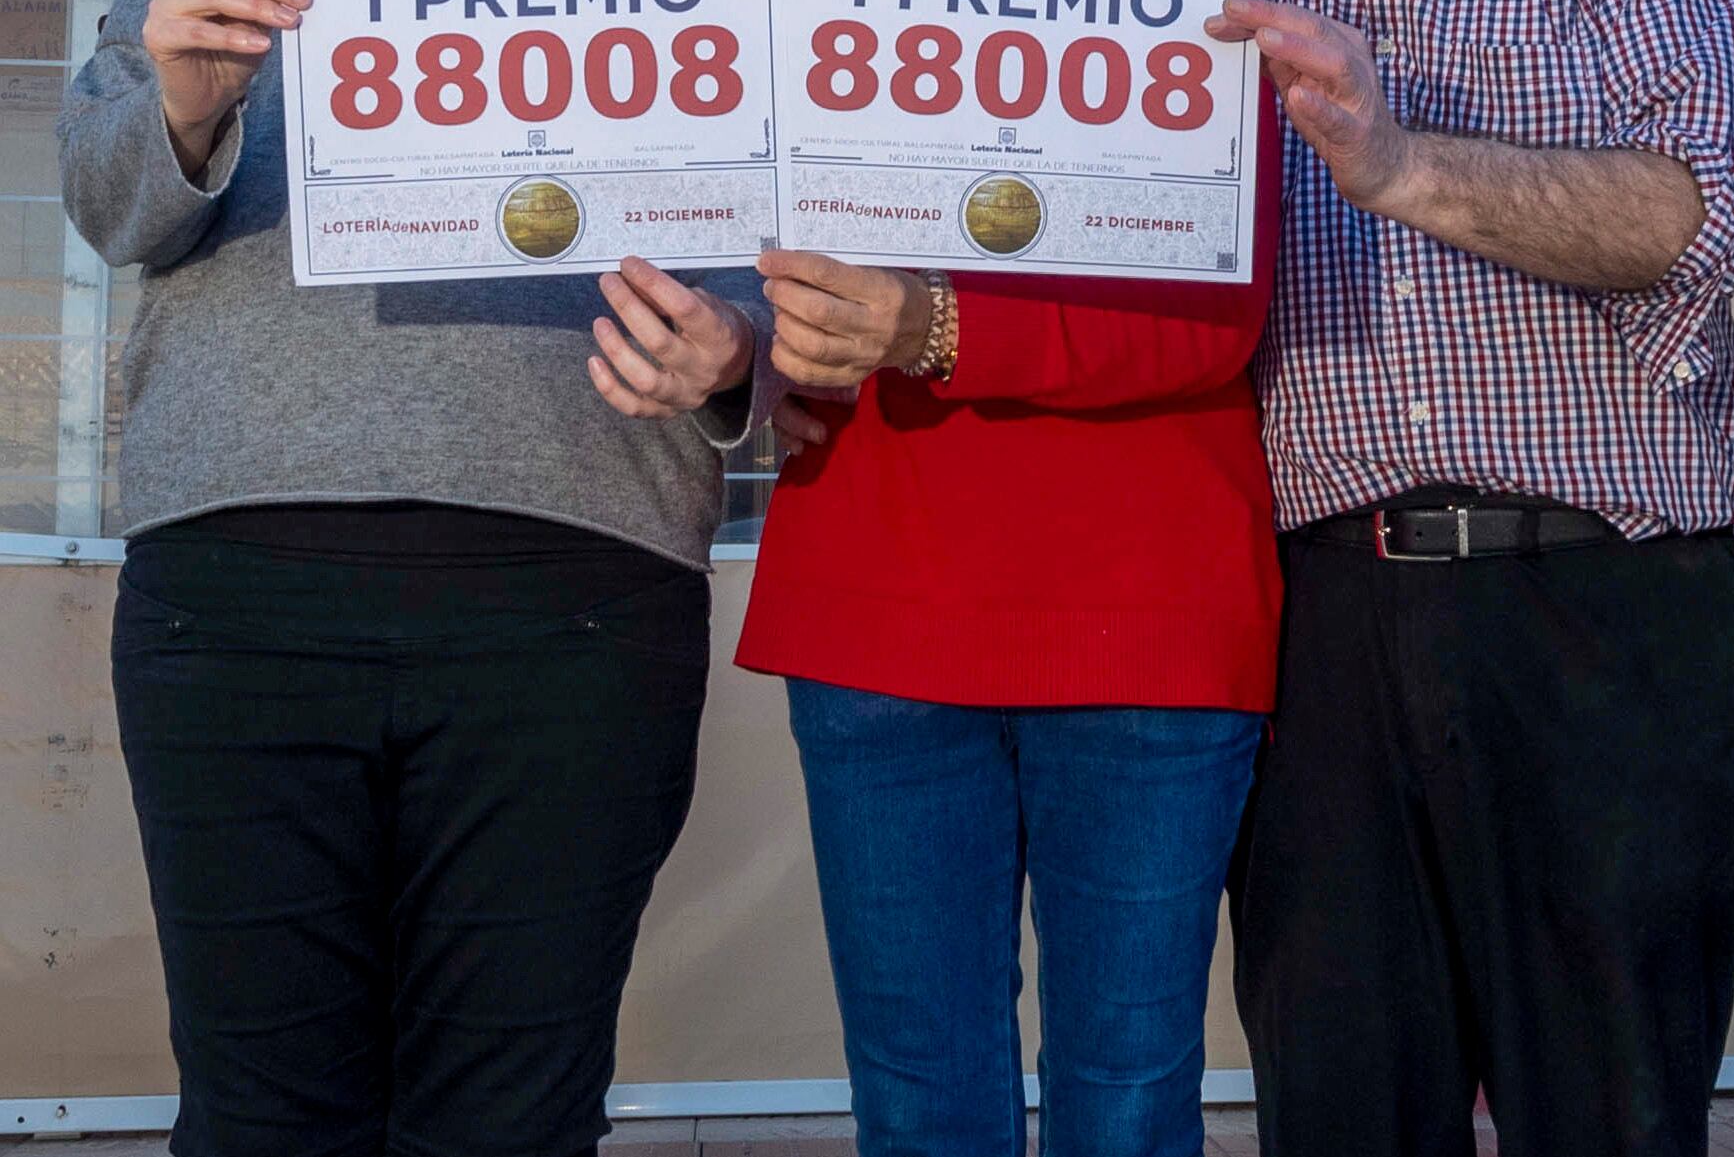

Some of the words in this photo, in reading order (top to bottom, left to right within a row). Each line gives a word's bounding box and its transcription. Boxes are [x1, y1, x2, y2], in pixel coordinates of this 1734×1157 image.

[329, 24, 744, 130] 88008
[805, 19, 1214, 131] 88008
[535, 147, 575, 157] Nacional
[1004, 145, 1043, 156] Nacional
[420, 166, 435, 176] NO
[438, 165, 460, 175] HAY
[462, 163, 500, 174] MAYOR
[503, 162, 540, 172] SUERTE
[545, 161, 567, 171] QUE
[570, 160, 584, 170] LA
[586, 159, 600, 169] DE
[604, 158, 660, 169] TENERNOS
[889, 153, 905, 163] NO
[907, 154, 928, 165] HAY
[931, 155, 969, 166] MAYOR
[971, 157, 1010, 168] SUERTE
[1013, 159, 1033, 170] QUE
[1038, 160, 1051, 170] LA
[1053, 161, 1068, 171] DE
[1072, 162, 1125, 173] TENERNOS
[624, 210, 642, 223] 22
[647, 207, 735, 222] DICIEMBRE
[1084, 215, 1103, 228] 22
[1109, 216, 1195, 233] DICIEMBRE
